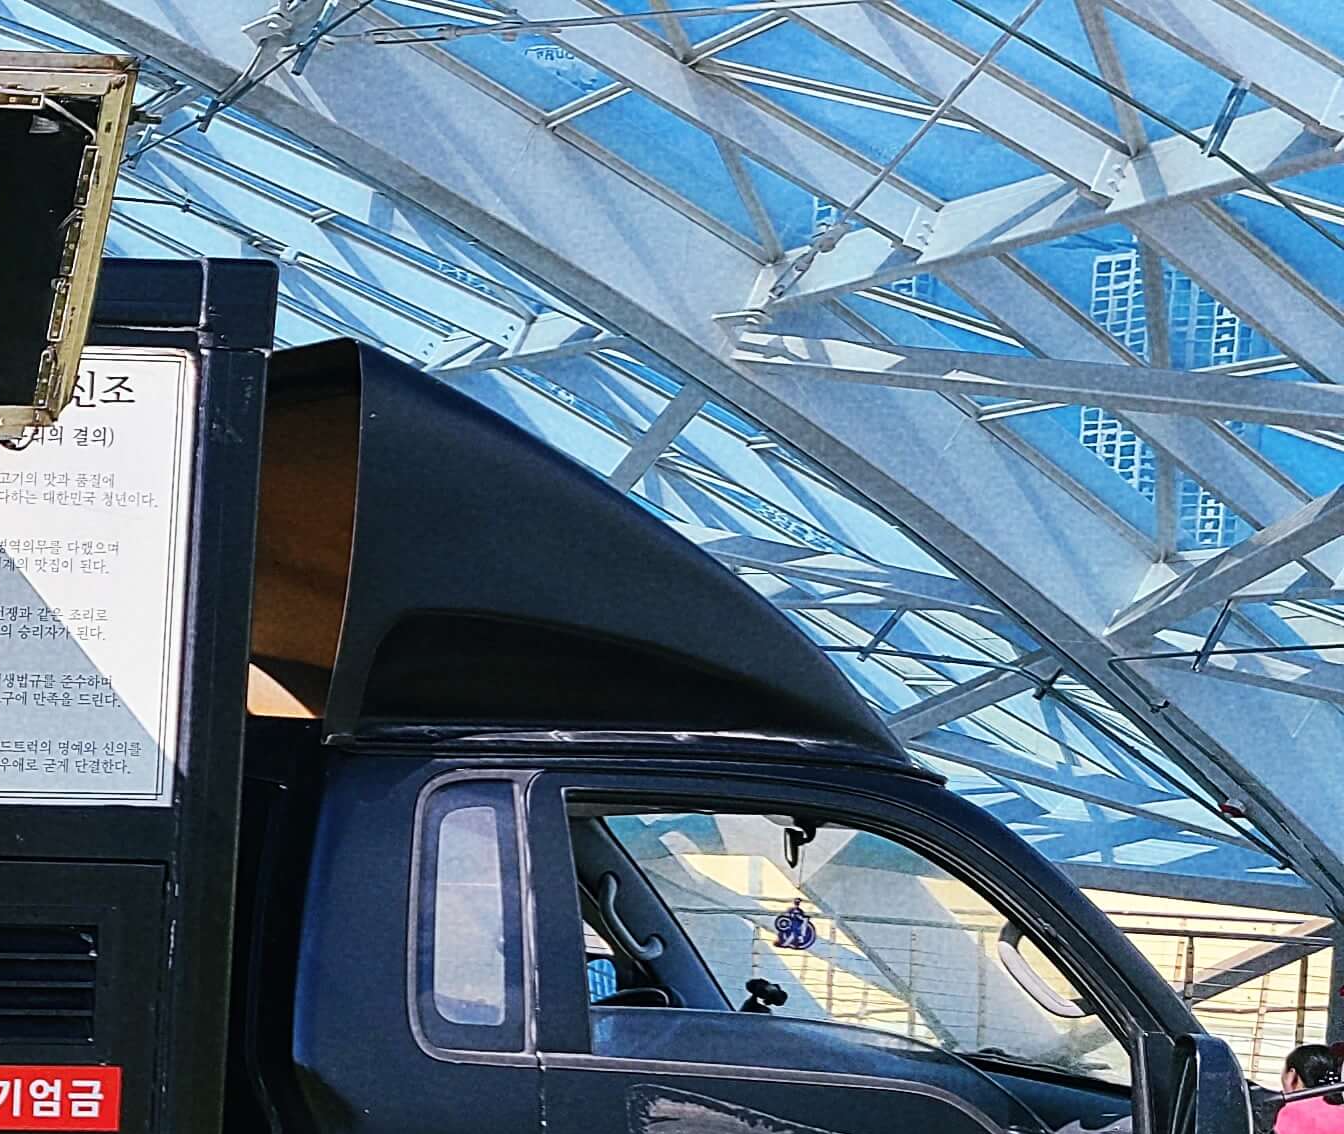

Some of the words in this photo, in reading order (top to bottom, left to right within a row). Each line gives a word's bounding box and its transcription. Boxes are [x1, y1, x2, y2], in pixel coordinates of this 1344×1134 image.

[73, 426, 114, 448] 결의)
[44, 471, 70, 487] 맛과
[43, 489, 96, 505] 대한민국
[35, 558, 73, 573] 맛집이
[80, 559, 110, 575] 된다.
[37, 607, 64, 623] 같은
[69, 608, 109, 622] 조리로
[18, 624, 70, 640] 승리자가
[76, 625, 106, 641] 된다.
[60, 674, 113, 690] 준수하며
[33, 692, 73, 707] 만족을
[77, 692, 122, 708] 드린다.
[57, 740, 98, 757] 명예와
[102, 741, 143, 758] 신의를
[43, 759, 69, 774] 굳게
[74, 759, 132, 775] 단결한다.
